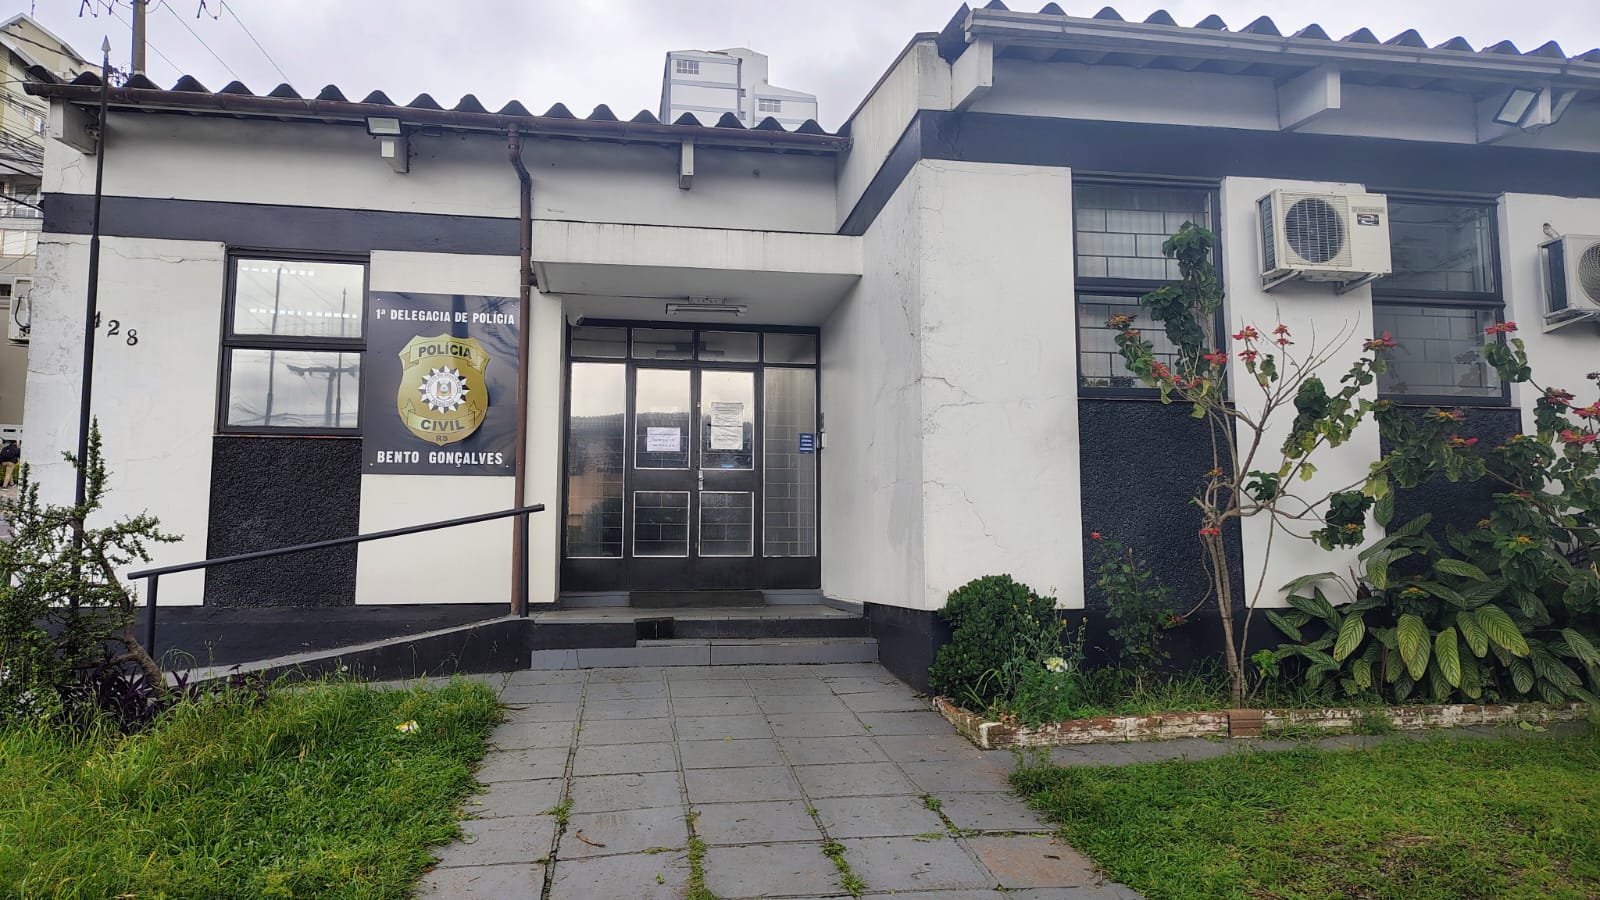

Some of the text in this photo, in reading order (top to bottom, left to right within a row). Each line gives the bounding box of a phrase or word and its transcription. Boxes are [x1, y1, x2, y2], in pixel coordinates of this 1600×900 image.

[390, 309, 451, 322] DELEGACIA
[454, 311, 468, 323] DE
[472, 310, 515, 325] POLÍCIA
[418, 343, 473, 359] POLÍCIA
[420, 419, 465, 432] CIVIL
[376, 450, 503, 467] BENTO GONÇALVES
